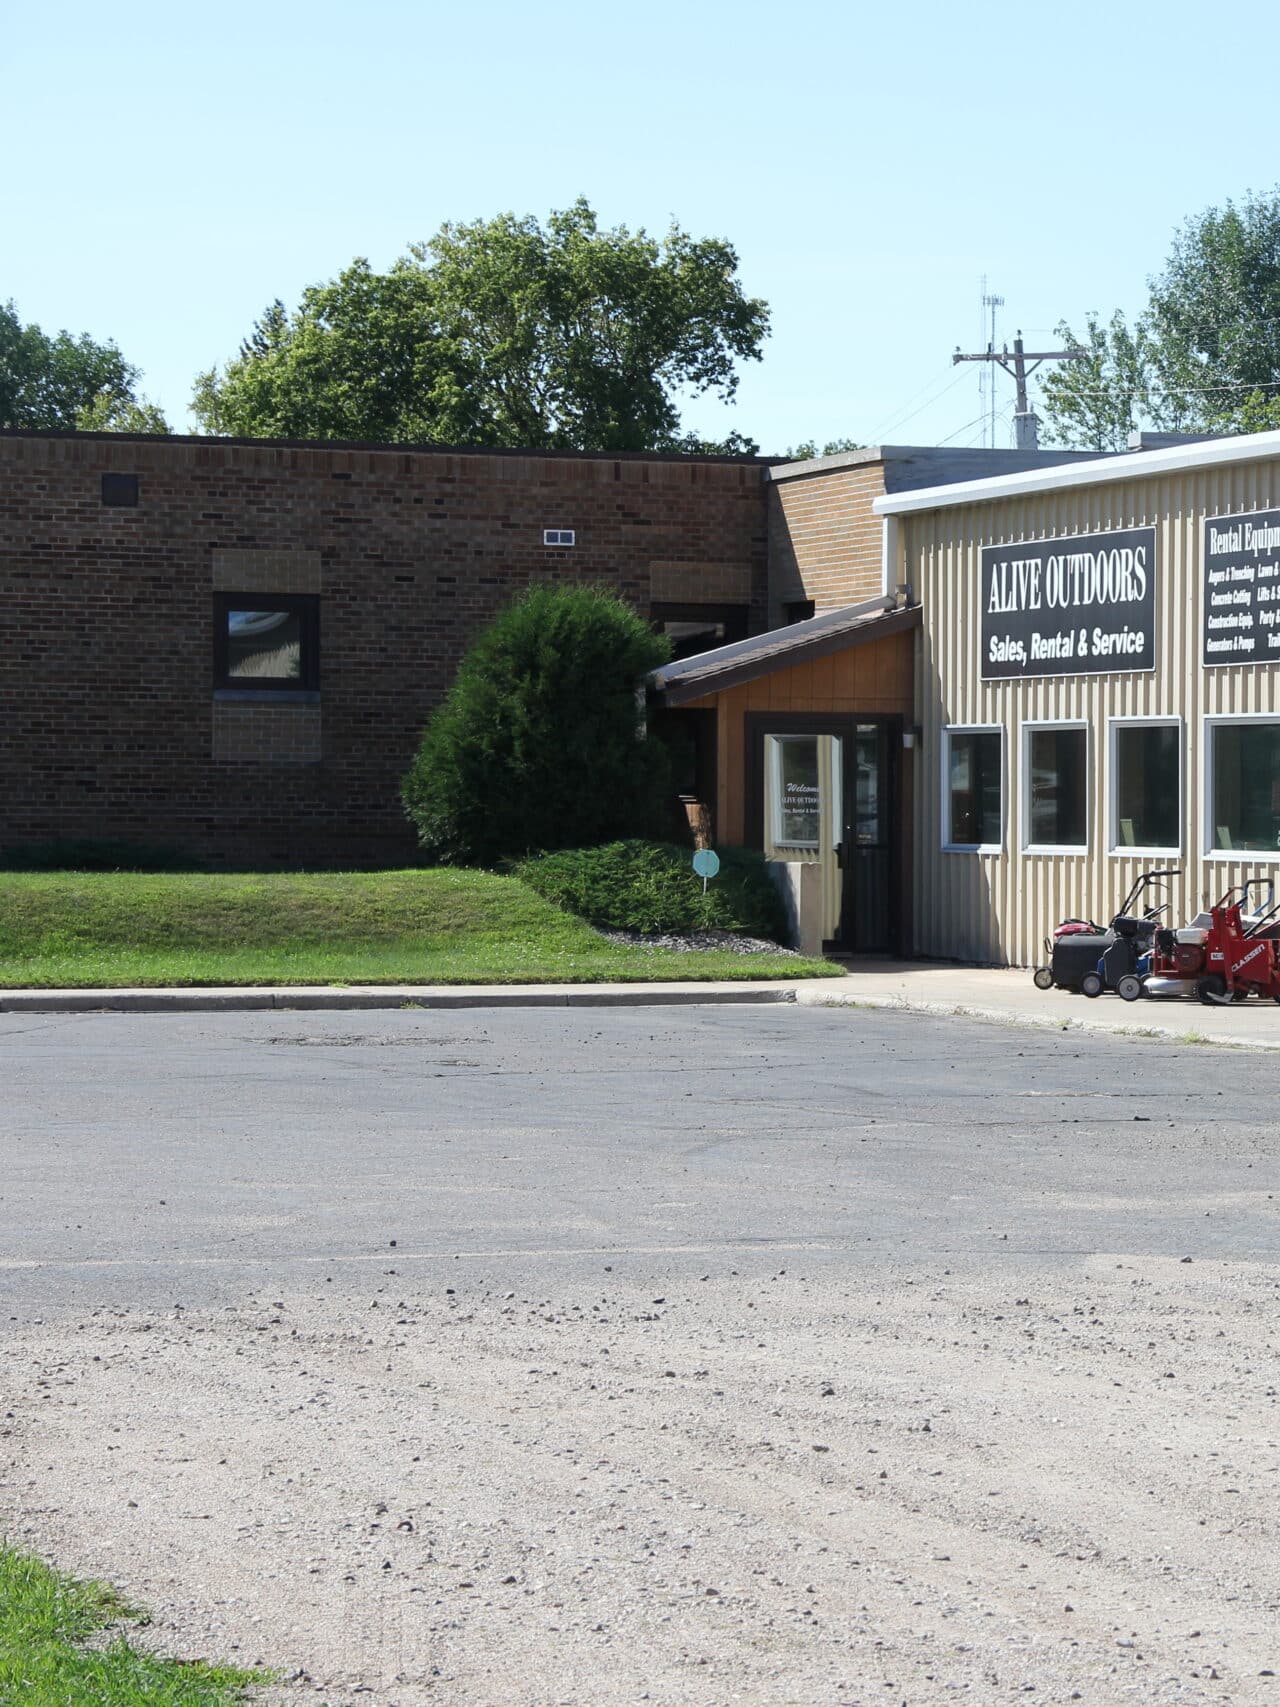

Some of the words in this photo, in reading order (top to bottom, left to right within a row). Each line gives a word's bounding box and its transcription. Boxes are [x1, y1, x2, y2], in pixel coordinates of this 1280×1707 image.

[1210, 524, 1242, 555] Rental
[1225, 567, 1230, 581] &
[1258, 563, 1273, 577] Lawn
[1274, 561, 1279, 576] &
[987, 558, 1041, 613] ALIVE
[1046, 546, 1146, 608] OUTDOORS
[1211, 591, 1233, 606] Concrete
[1233, 589, 1251, 606] Cutting
[1257, 587, 1270, 601] Lifts
[1270, 586, 1275, 600] &
[1208, 613, 1238, 629] Construction
[1259, 610, 1275, 627] Party
[1275, 609, 1280, 623] &
[989, 634, 1027, 667] Sales,
[1030, 630, 1074, 660] Rental
[1077, 628, 1088, 656] &
[1092, 626, 1144, 655] Service
[1207, 638, 1233, 652] Generators
[1233, 636, 1238, 650] &
[1238, 636, 1255, 653] Pumps
